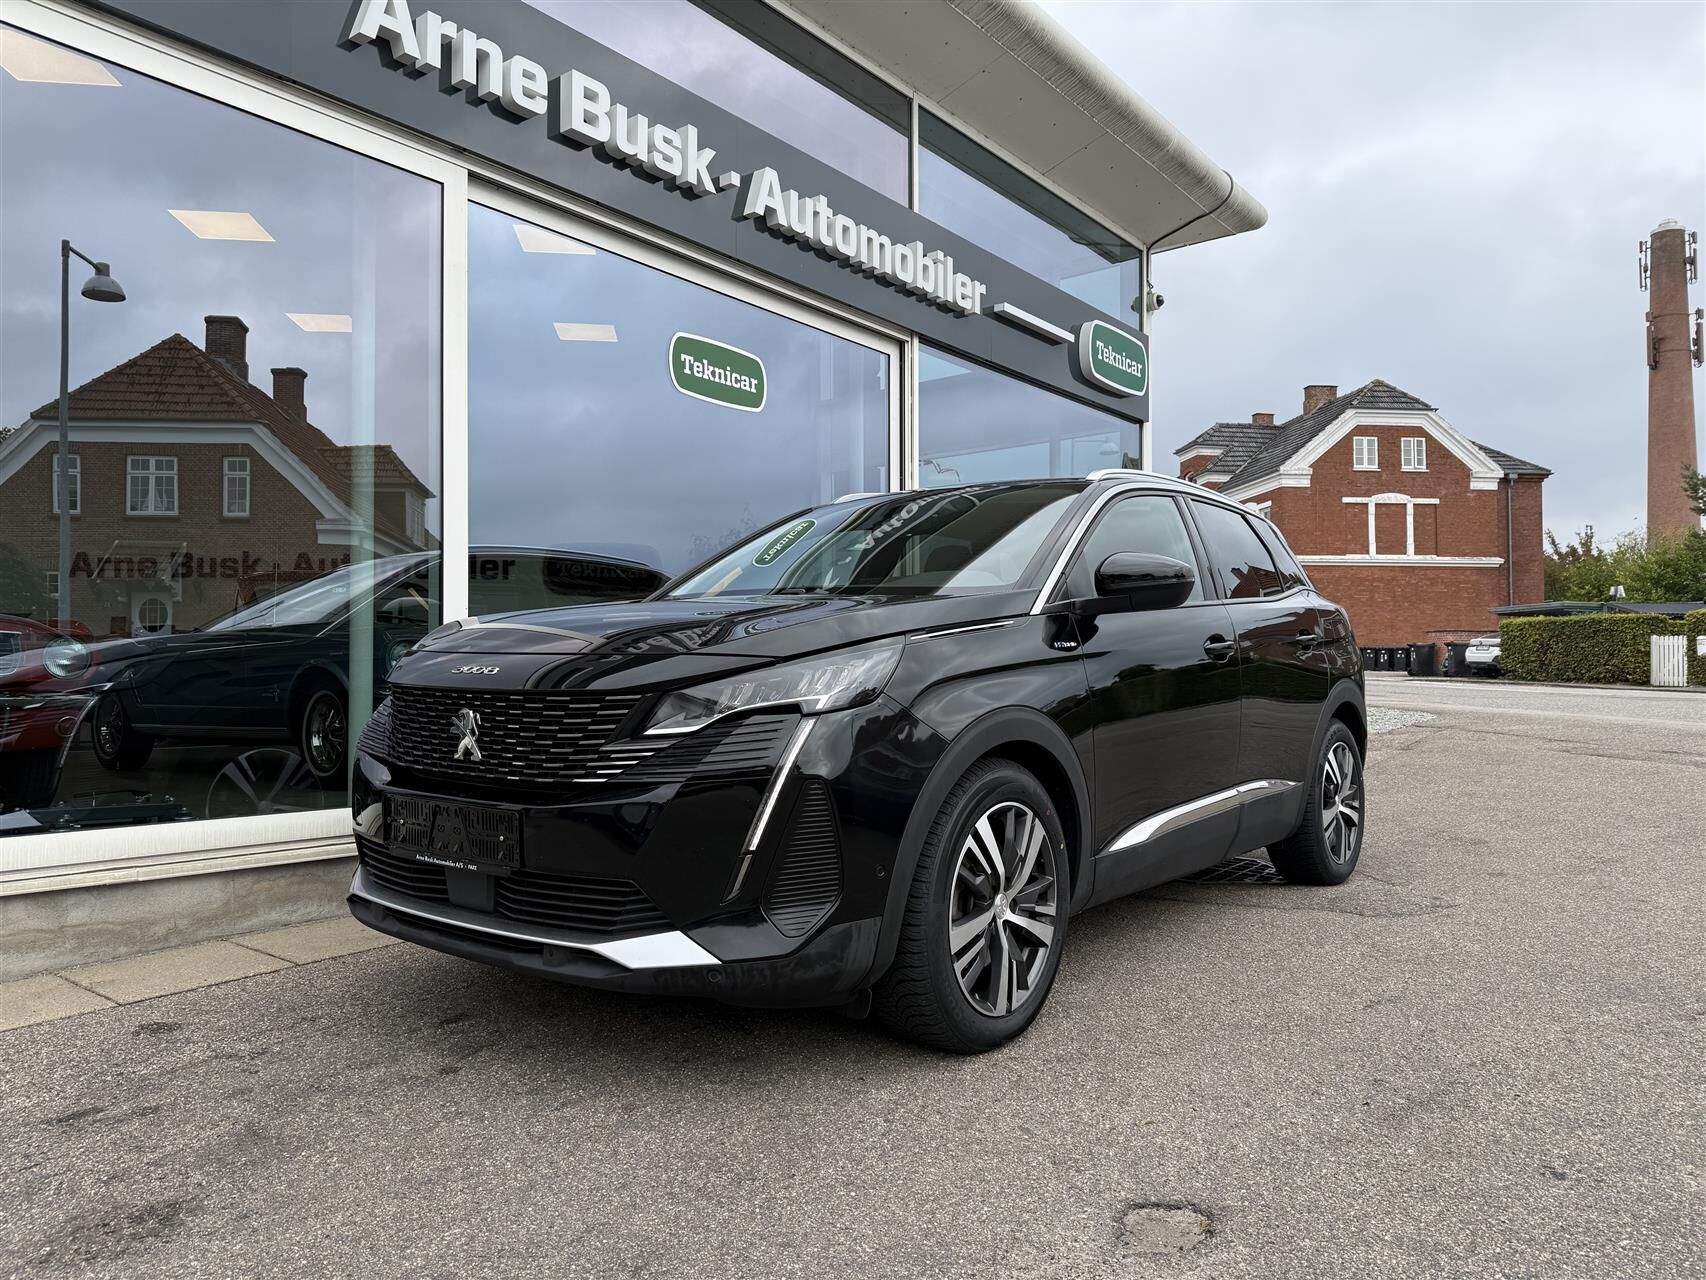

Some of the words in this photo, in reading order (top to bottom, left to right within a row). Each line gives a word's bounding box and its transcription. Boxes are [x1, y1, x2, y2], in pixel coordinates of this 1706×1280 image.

[349, 0, 548, 116] Arne
[560, 69, 717, 195] Busk
[743, 166, 987, 315] Automobiler
[680, 352, 758, 394] Teknicar
[1096, 341, 1143, 378] Teknicar
[69, 551, 158, 579] Arne
